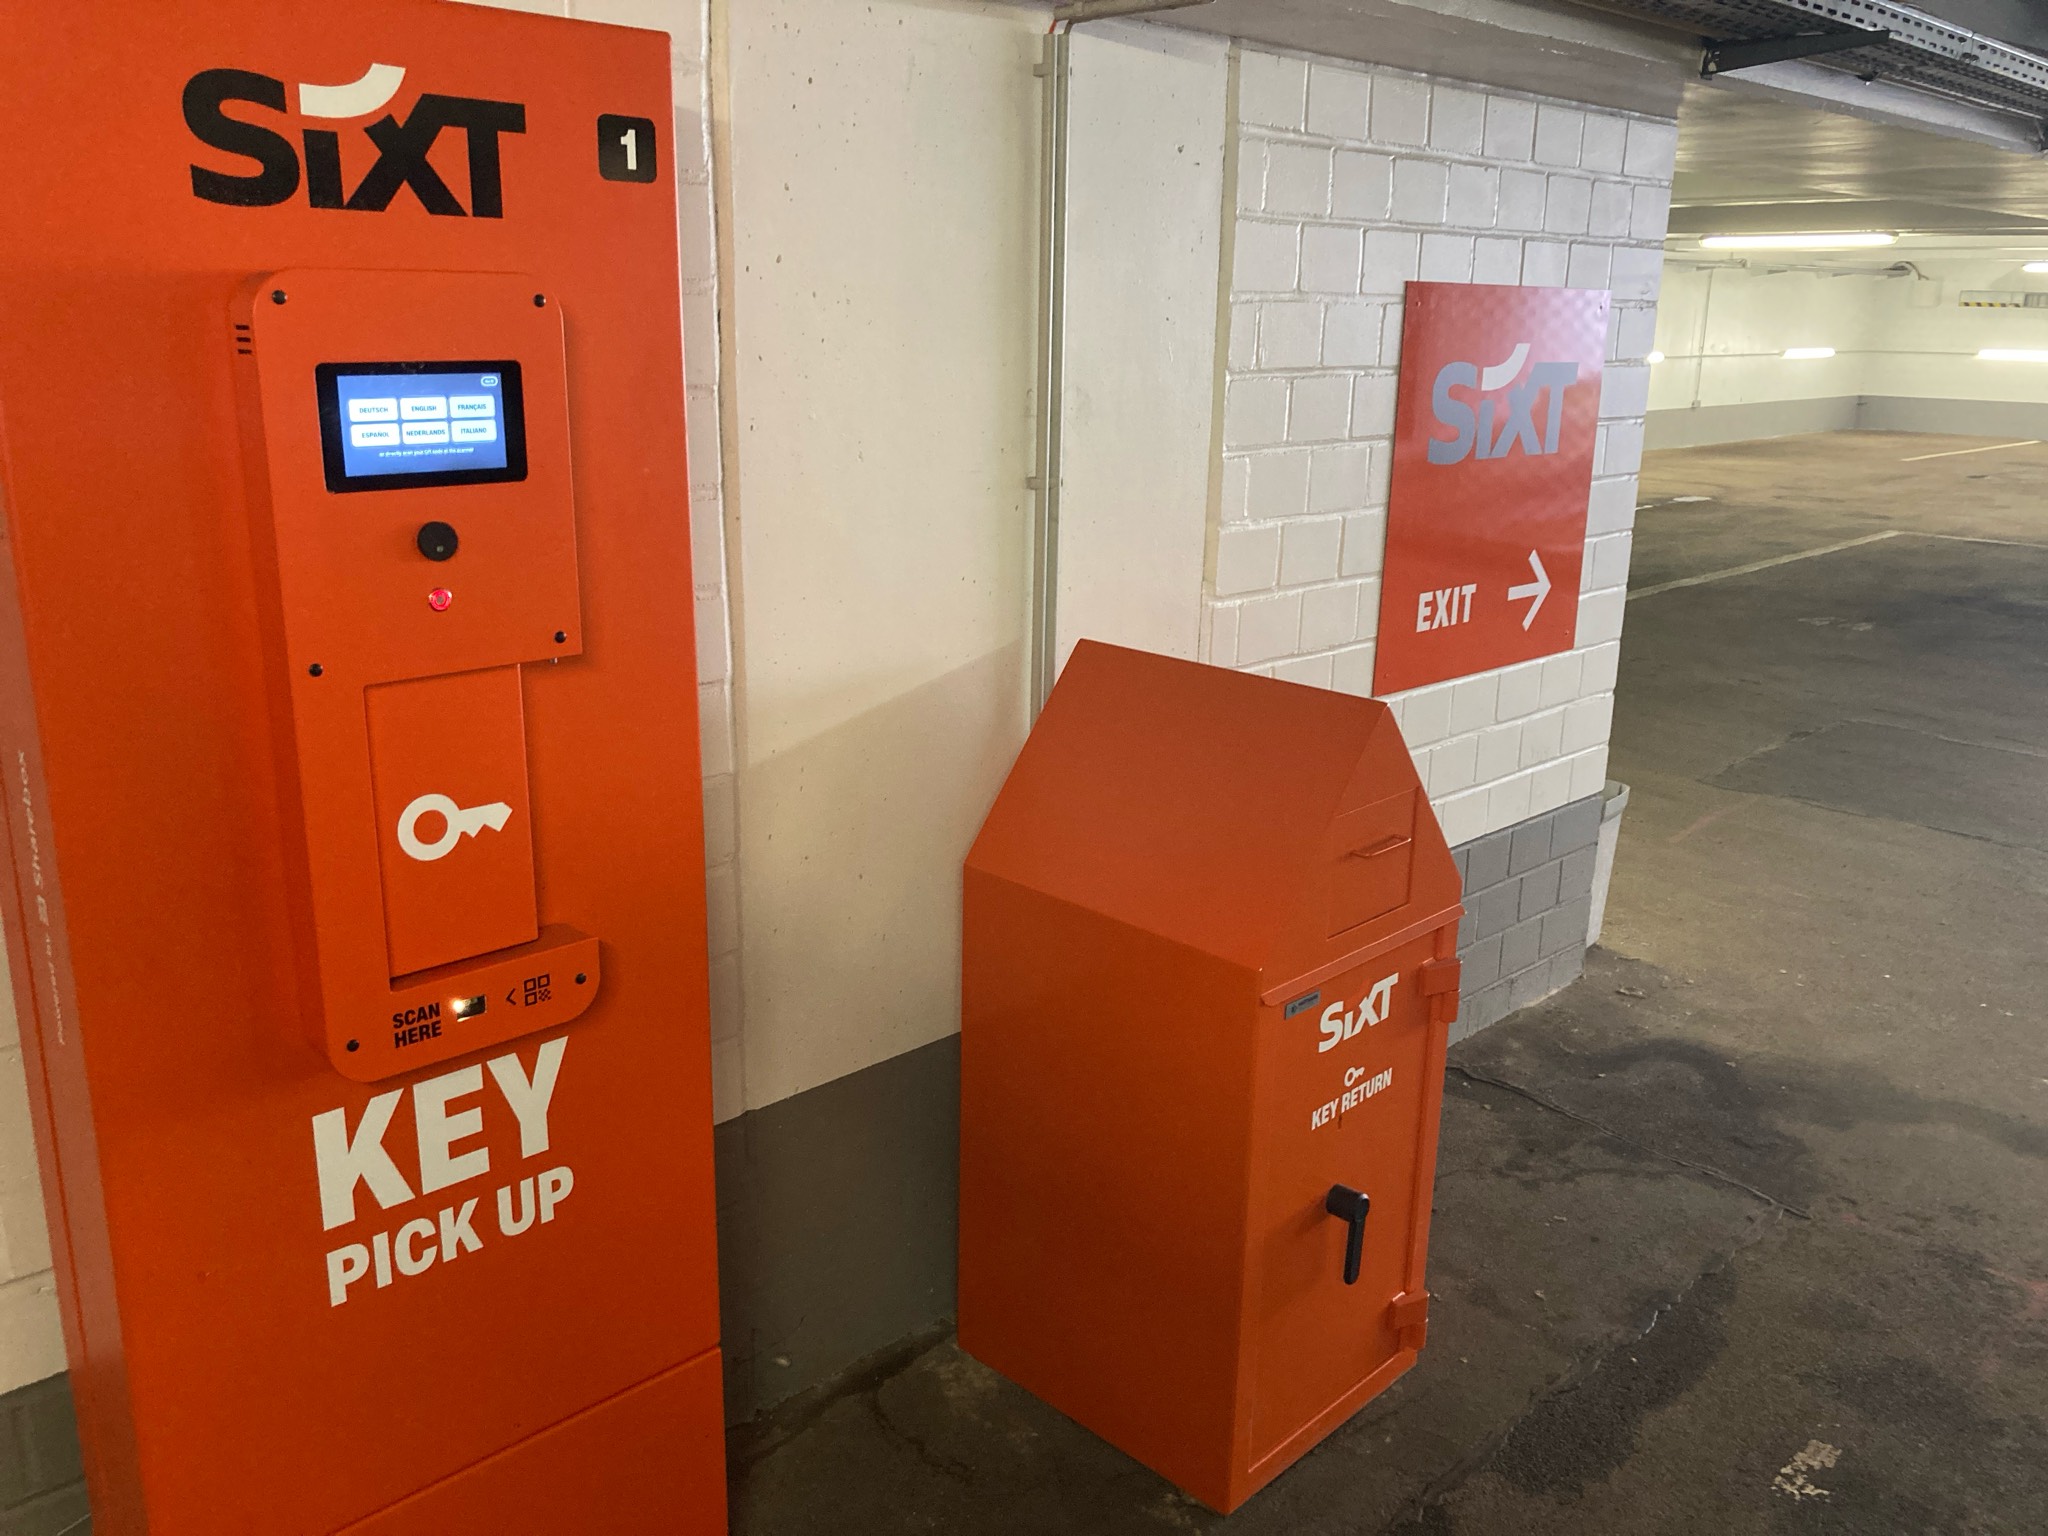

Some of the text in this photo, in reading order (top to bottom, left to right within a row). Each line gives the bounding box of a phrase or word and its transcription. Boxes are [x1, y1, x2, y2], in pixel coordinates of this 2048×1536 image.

[619, 128, 638, 171] 1
[457, 404, 487, 412] FRANÇAIS
[406, 429, 446, 437] NEDERLANDS
[460, 427, 487, 435] ITALIANO
[1415, 583, 1477, 633] EXIT
[392, 1002, 441, 1029] SCAN
[393, 1020, 442, 1049] HERE
[1311, 1067, 1393, 1131] KEY RETURN
[312, 1035, 569, 1232] KEY
[326, 1166, 575, 1308] PICK UP
